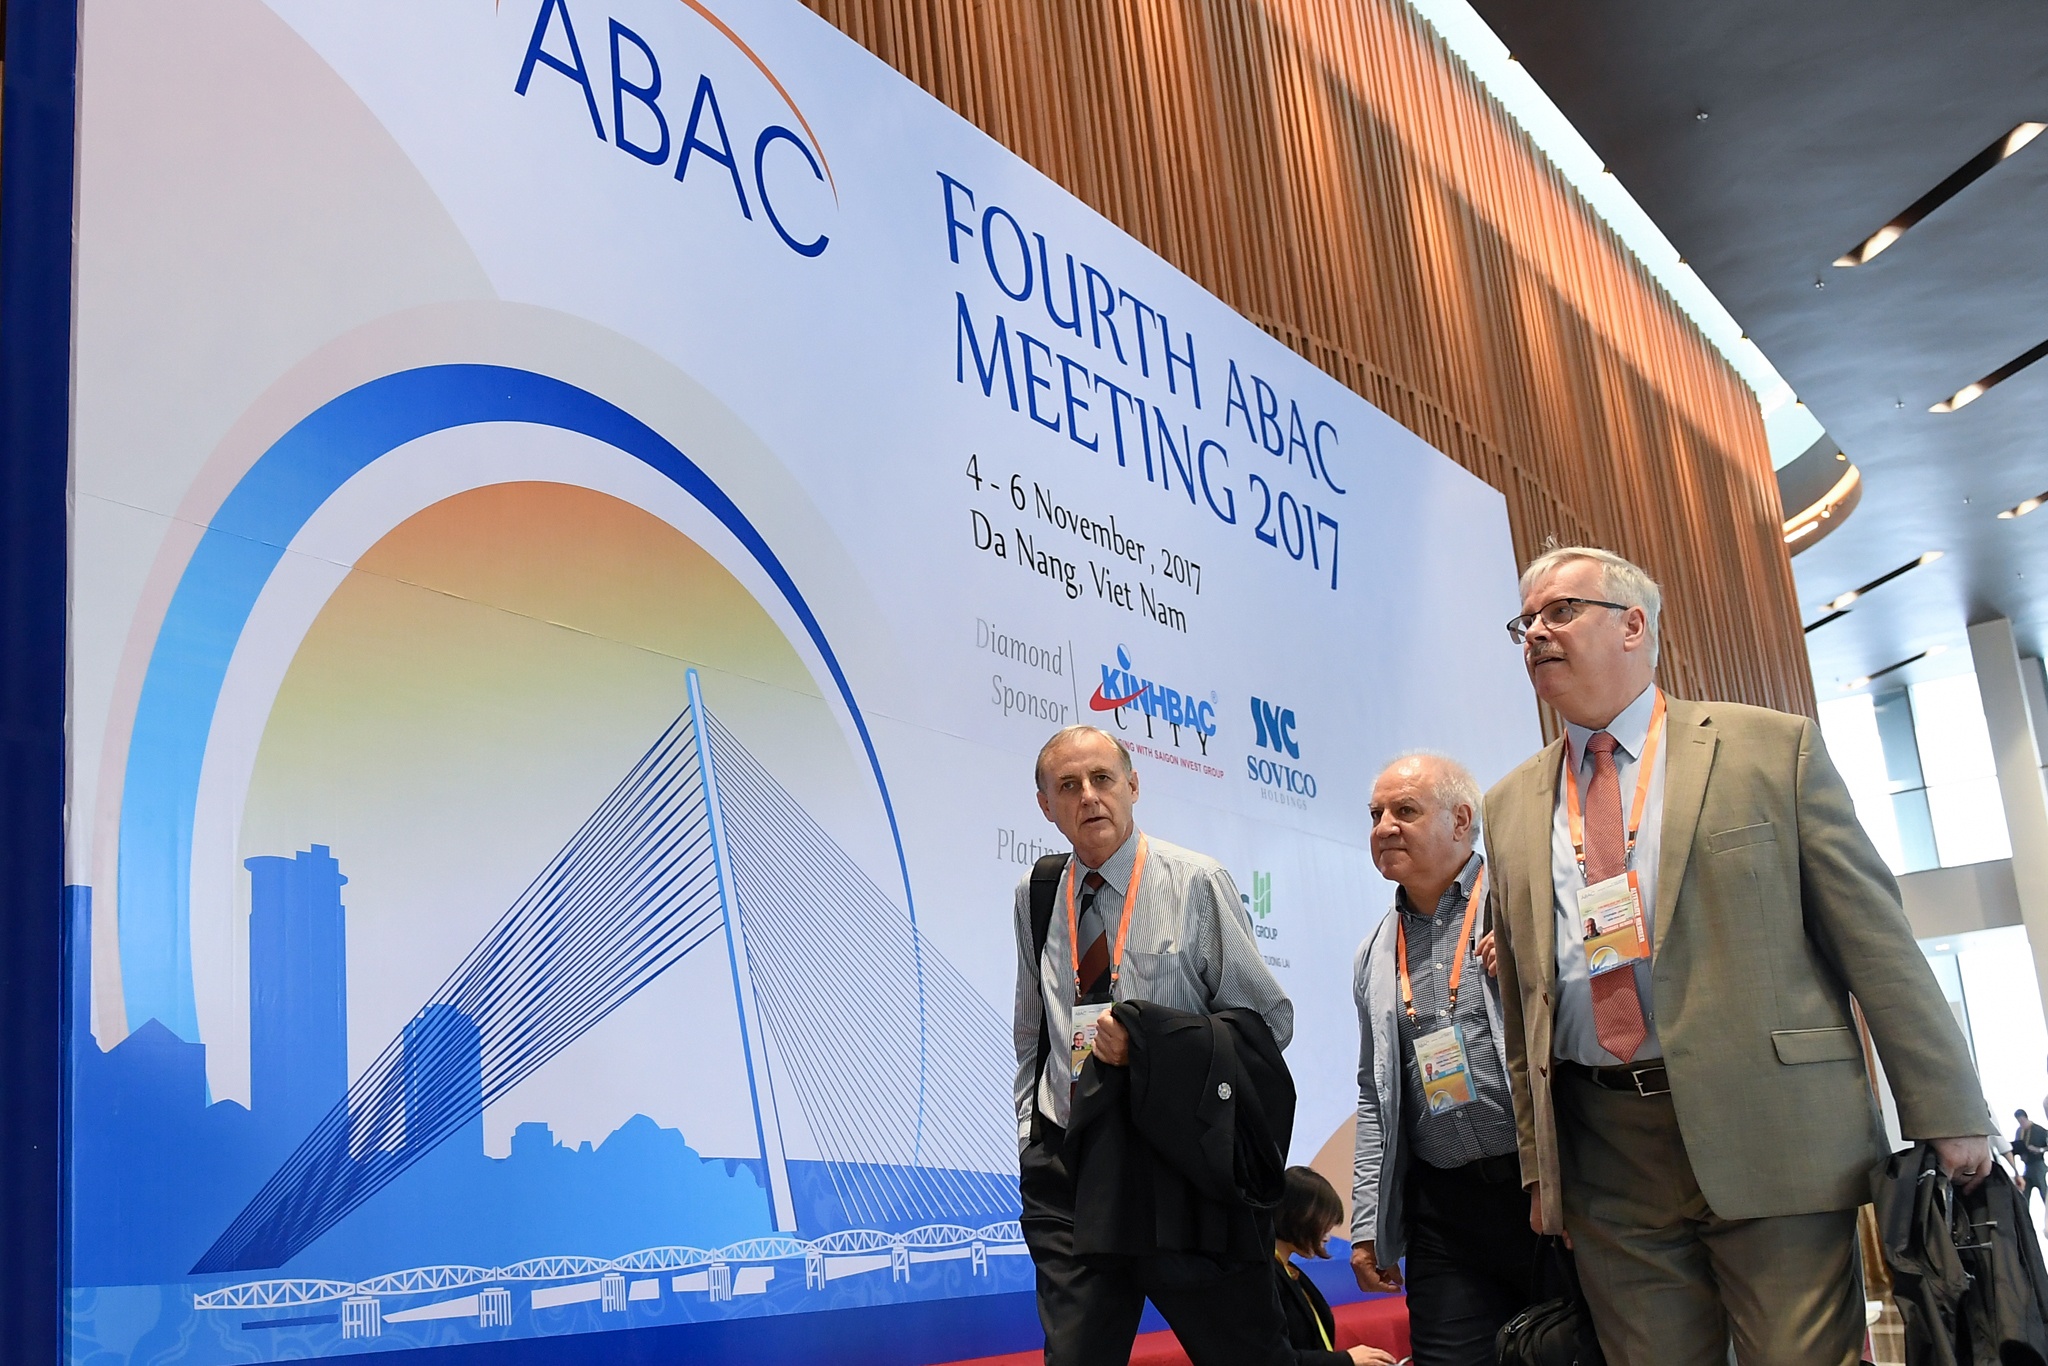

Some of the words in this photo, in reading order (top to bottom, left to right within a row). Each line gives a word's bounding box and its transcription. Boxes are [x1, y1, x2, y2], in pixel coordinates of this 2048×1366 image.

[514, 0, 830, 257] ABAC
[936, 170, 1202, 411] FOURTH
[1225, 358, 1347, 495] ABAC
[955, 291, 1236, 525] MEETING
[1249, 473, 1339, 591] 2017
[966, 454, 983, 492] 4
[1010, 473, 1026, 511] 6
[1161, 548, 1201, 596] 2017
[969, 508, 1007, 559] Da
[1015, 527, 1084, 600] Nang,
[1088, 560, 1135, 612] Viet
[1139, 582, 1188, 634] Nam
[975, 617, 1064, 677] Diamond
[991, 674, 1069, 725] Sponsor
[1136, 743, 1154, 758] WITH
[1154, 749, 1179, 766] SAIGON
[1179, 757, 1202, 773] INVEST
[1202, 764, 1225, 780] GROUP
[1247, 755, 1317, 799] SOVICO
[1260, 787, 1308, 811] HOLDINGS
[1255, 924, 1278, 941] GROUP
